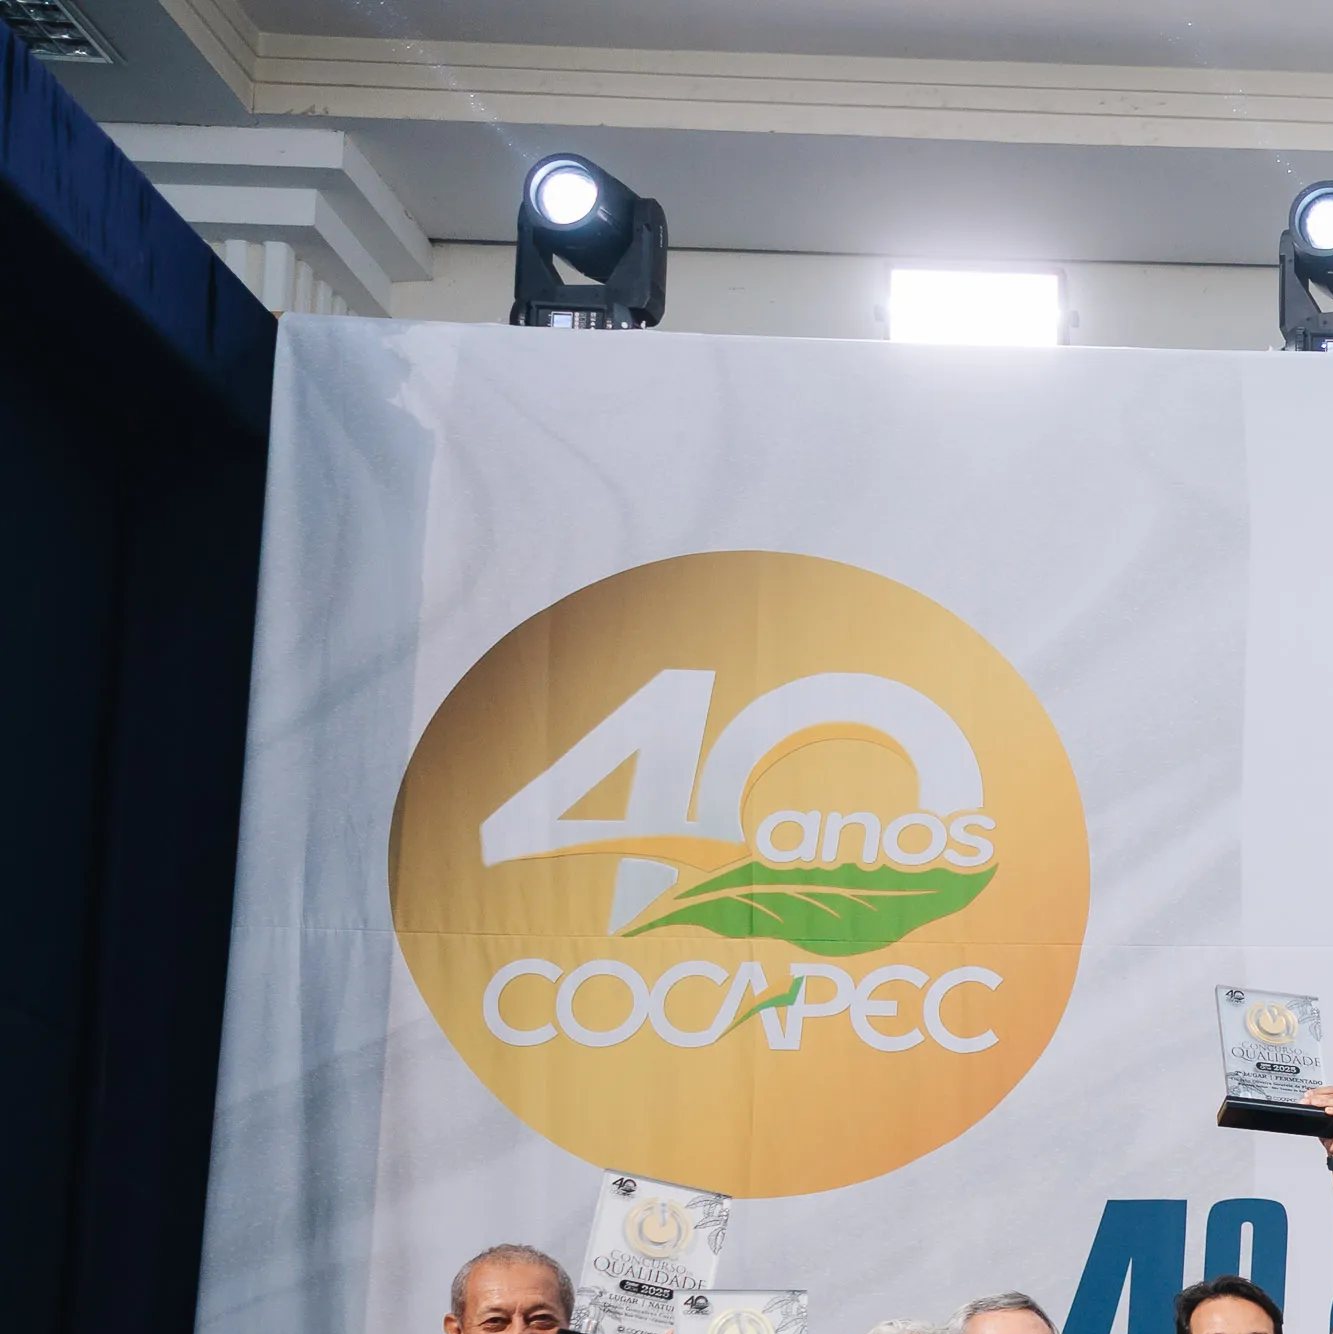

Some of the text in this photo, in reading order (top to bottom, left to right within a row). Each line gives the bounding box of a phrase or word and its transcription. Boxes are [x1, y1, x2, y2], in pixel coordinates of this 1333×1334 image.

[480, 669, 984, 936] 40
[755, 810, 996, 867] anos
[482, 958, 1003, 1054] COCAPEC
[1231, 1046, 1321, 1067] QUALIDADE
[1241, 1041, 1302, 1054] CONCURSO
[1273, 1064, 1297, 1073] 2025
[1275, 1075, 1323, 1085] FERMENTADO
[610, 1249, 687, 1275] CONCURSO
[593, 1256, 708, 1291] QUALIDADE
[609, 1293, 675, 1312] LUGAR NATU
[640, 1285, 671, 1299] 2025
